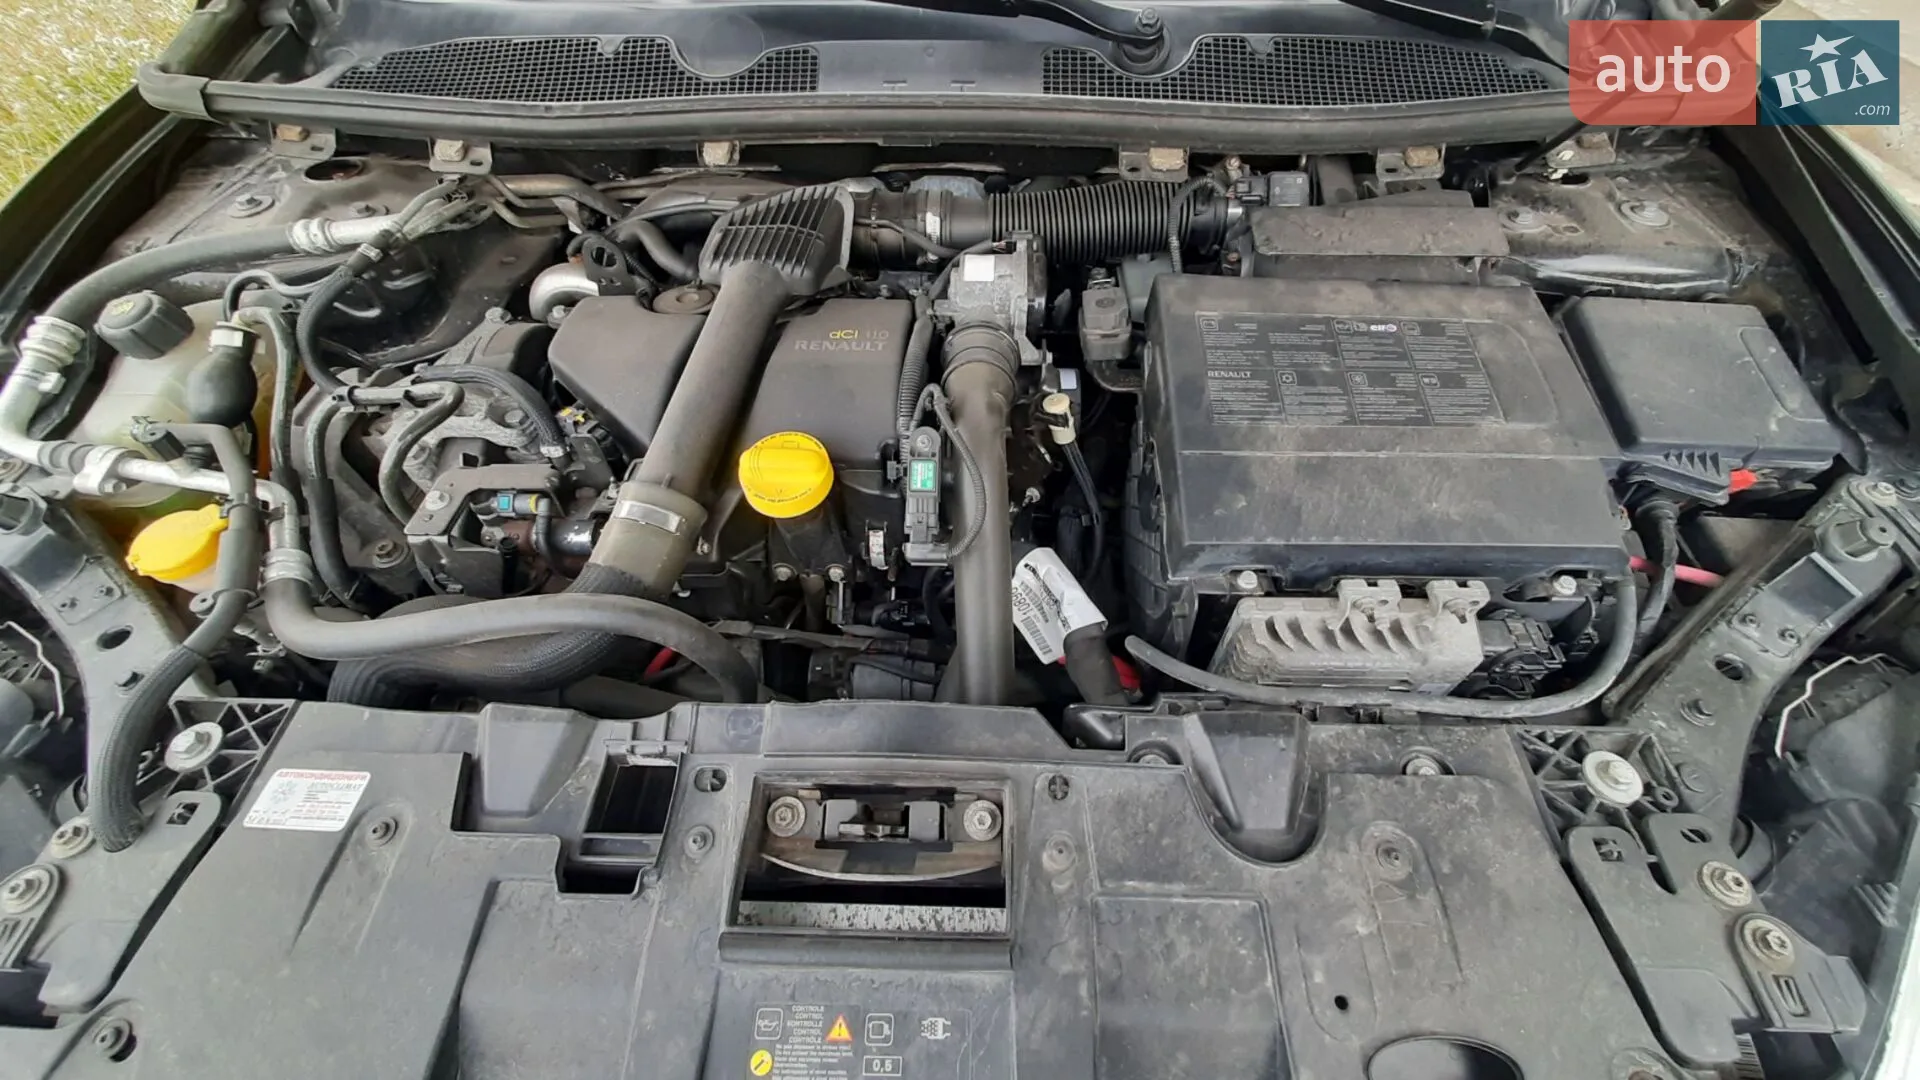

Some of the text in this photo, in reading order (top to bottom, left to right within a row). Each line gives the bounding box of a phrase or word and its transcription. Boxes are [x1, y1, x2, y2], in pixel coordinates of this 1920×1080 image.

[866, 329, 889, 340] 110
[795, 340, 886, 352] RENAULT
[1207, 370, 1252, 379] RENAULT
[786, 1020, 823, 1028] KONTROLLE
[793, 1028, 822, 1036] CONTROL
[872, 1059, 892, 1072] 0,5
